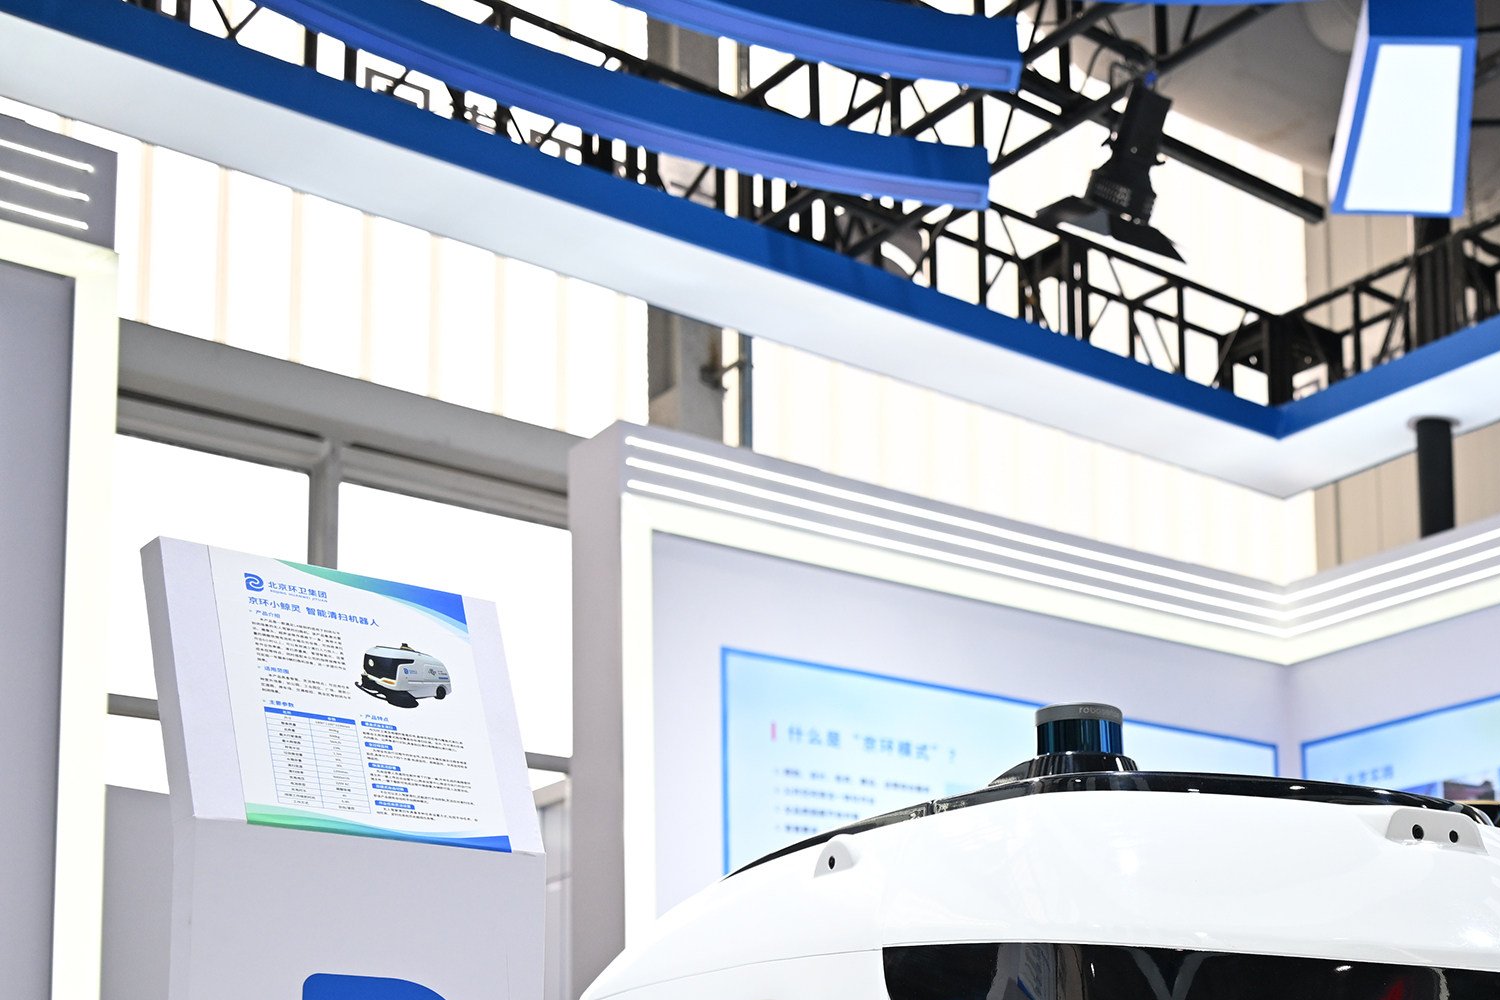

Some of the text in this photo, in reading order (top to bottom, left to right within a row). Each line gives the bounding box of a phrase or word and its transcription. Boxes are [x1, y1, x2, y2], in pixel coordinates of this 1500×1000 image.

[268, 581, 328, 599] 北京环卫集团
[248, 597, 380, 628] 京环小鲸灵 智能清扫机器人
